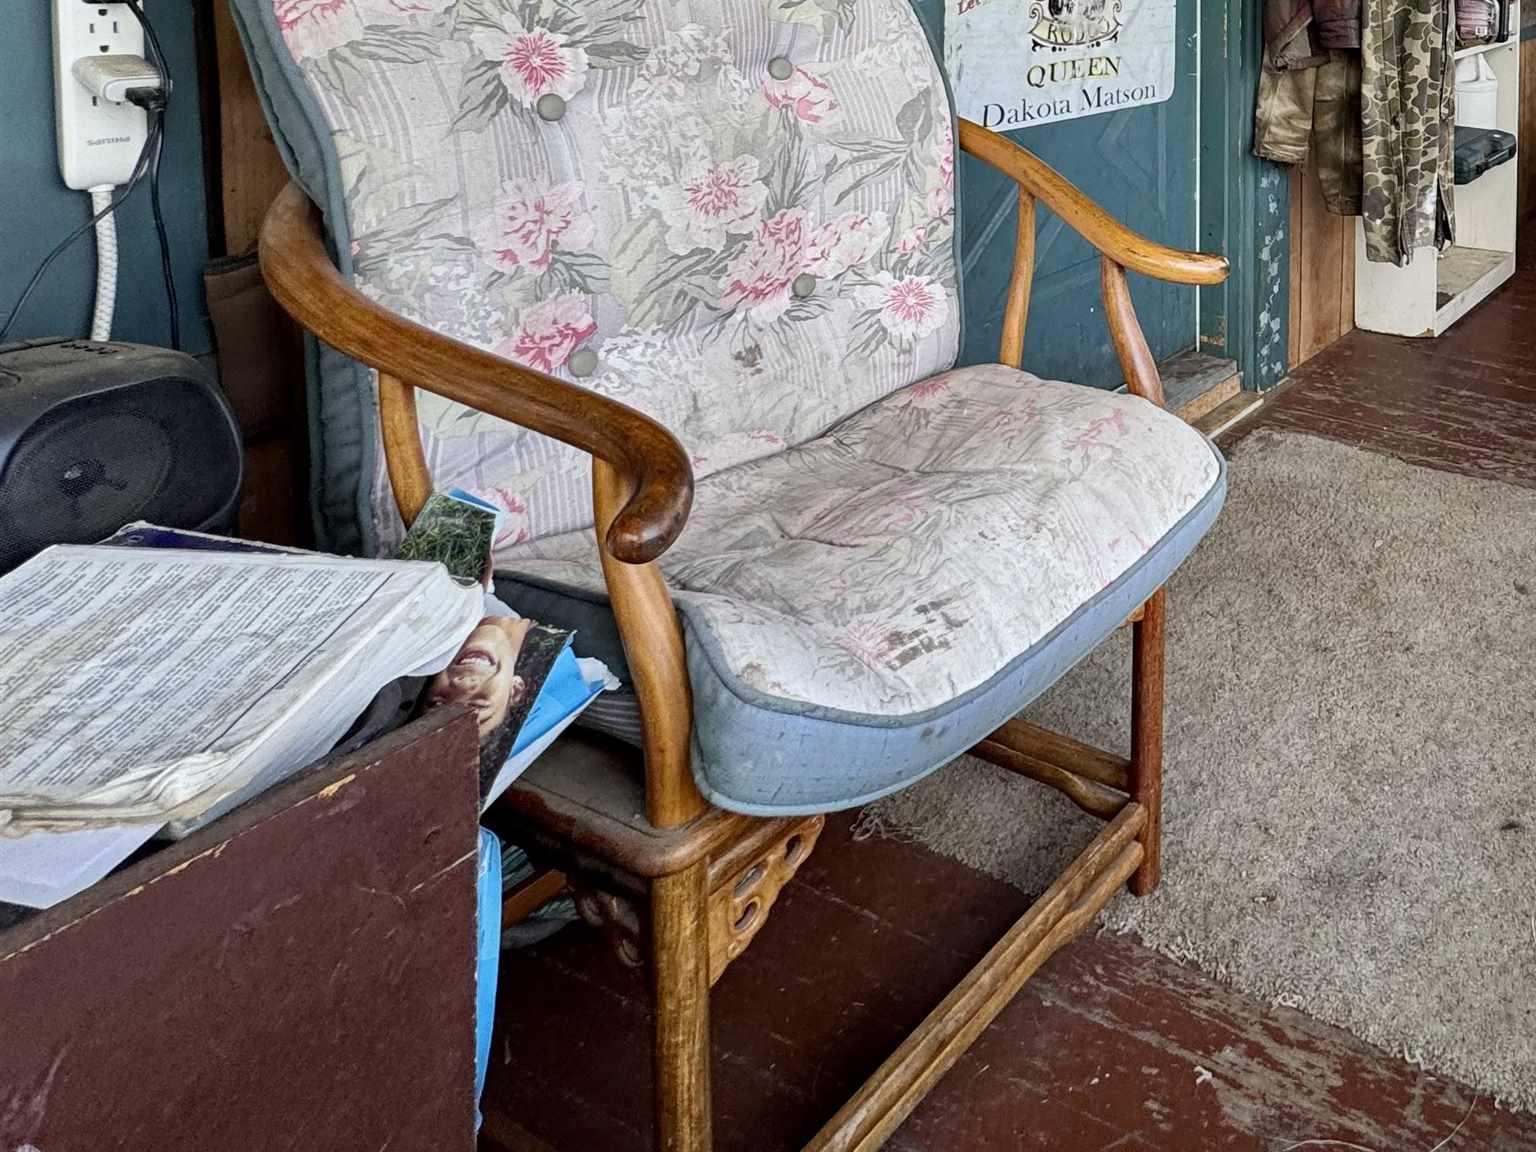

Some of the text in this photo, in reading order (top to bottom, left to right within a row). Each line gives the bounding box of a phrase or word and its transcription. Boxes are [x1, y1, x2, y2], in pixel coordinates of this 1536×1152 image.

[1027, 56, 1121, 88] QUEEN
[983, 83, 1157, 128] Dakota Matson
